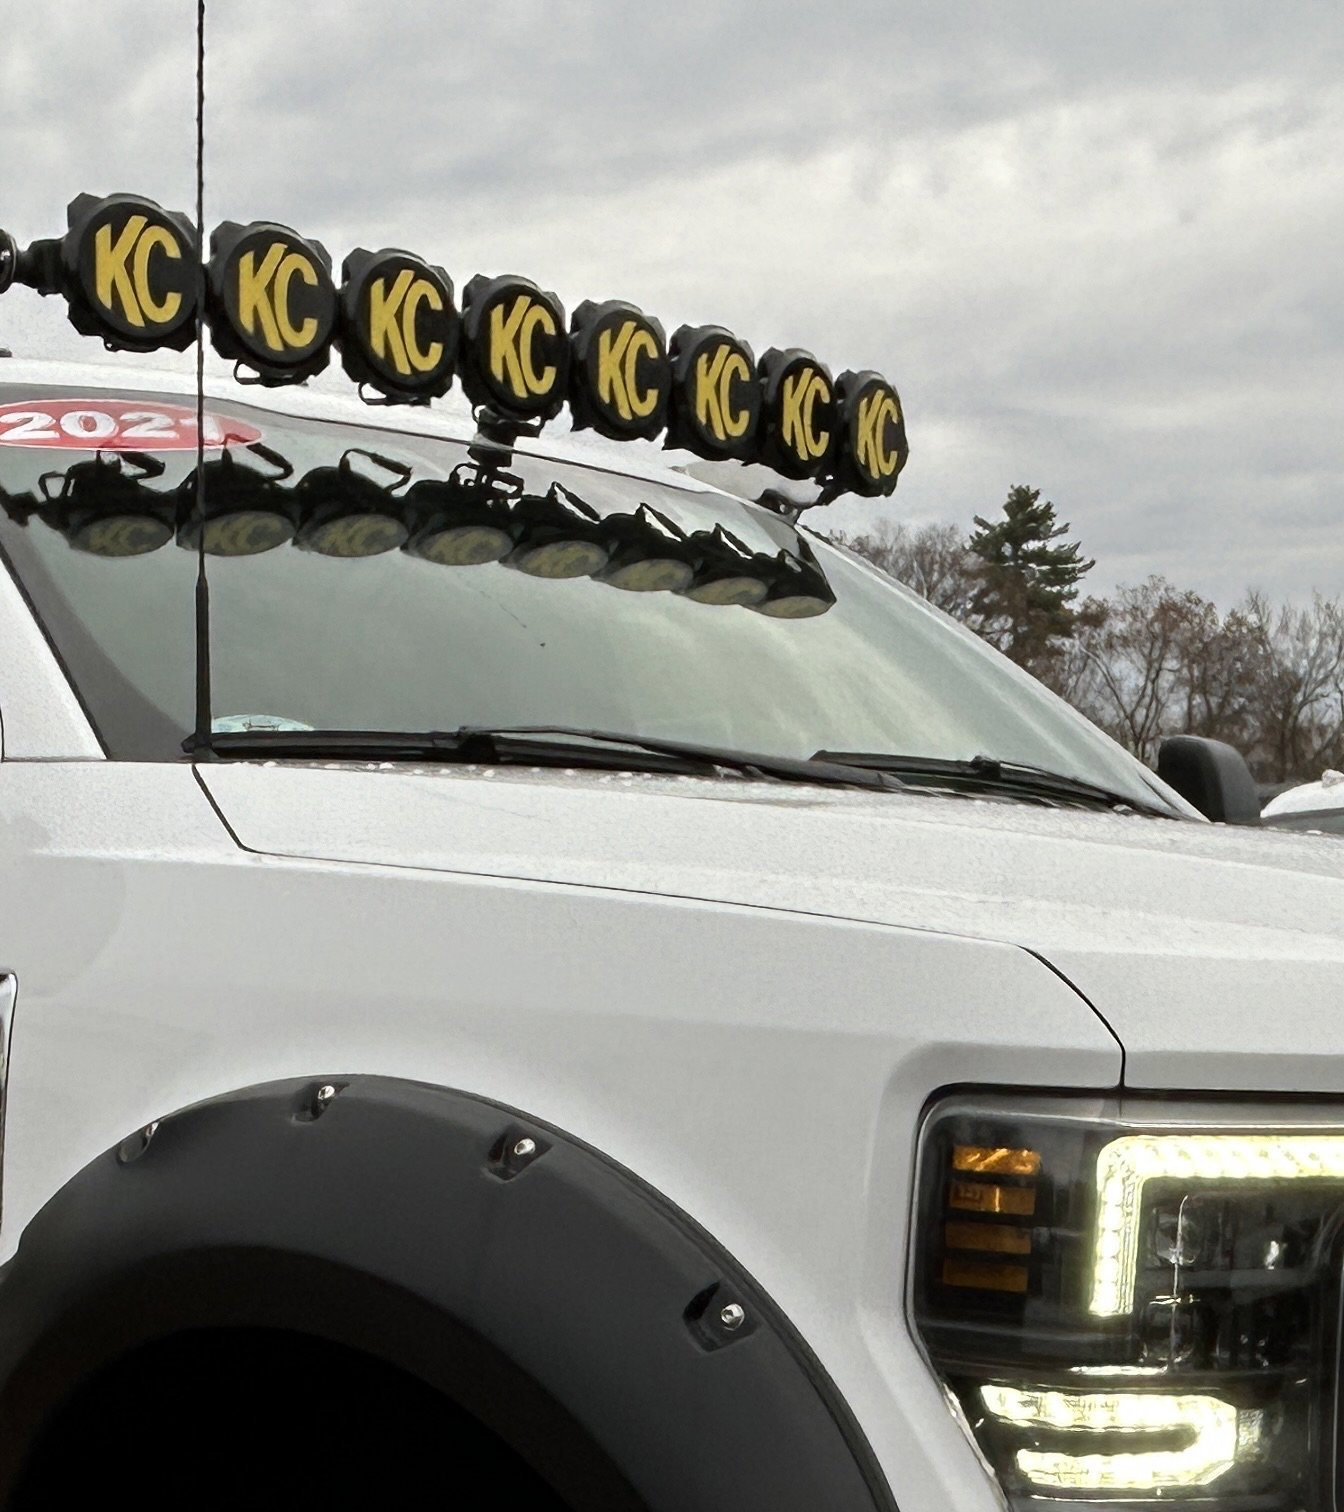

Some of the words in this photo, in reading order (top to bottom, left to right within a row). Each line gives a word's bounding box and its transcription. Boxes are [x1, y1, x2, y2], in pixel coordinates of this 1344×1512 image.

[94, 214, 182, 328] KC
[238, 242, 319, 352] KC
[369, 269, 444, 375] KC
[489, 295, 556, 398] KC
[597, 321, 659, 420] KC
[695, 344, 751, 441] KC
[781, 367, 831, 460] KC
[857, 389, 899, 478] KC
